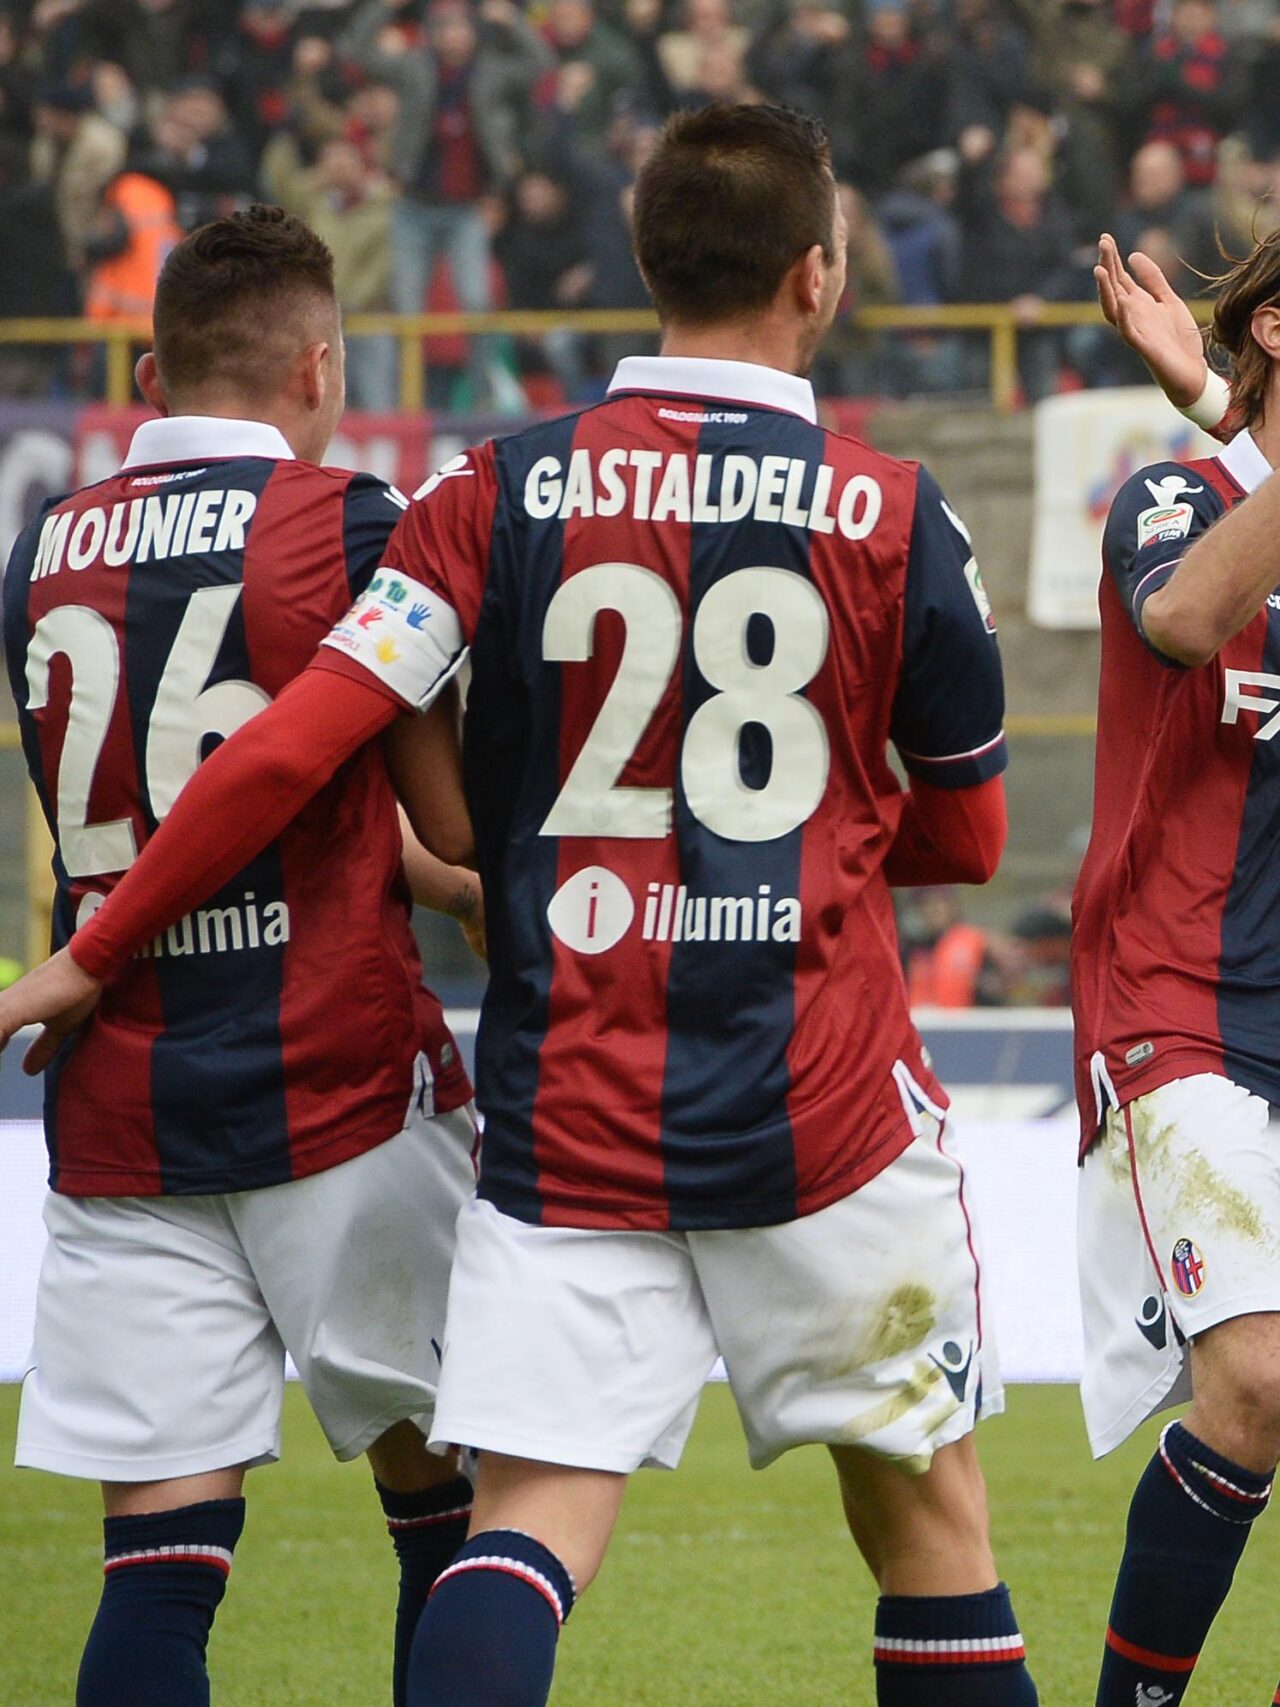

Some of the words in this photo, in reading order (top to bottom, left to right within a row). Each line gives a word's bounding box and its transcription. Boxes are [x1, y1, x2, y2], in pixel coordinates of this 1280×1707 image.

[30, 489, 257, 582] MOUNIER
[524, 449, 882, 541] GASTALDELLO
[26, 583, 275, 878] 26
[538, 562, 831, 843] 28
[132, 891, 290, 960] umia
[642, 884, 801, 942] illumia
